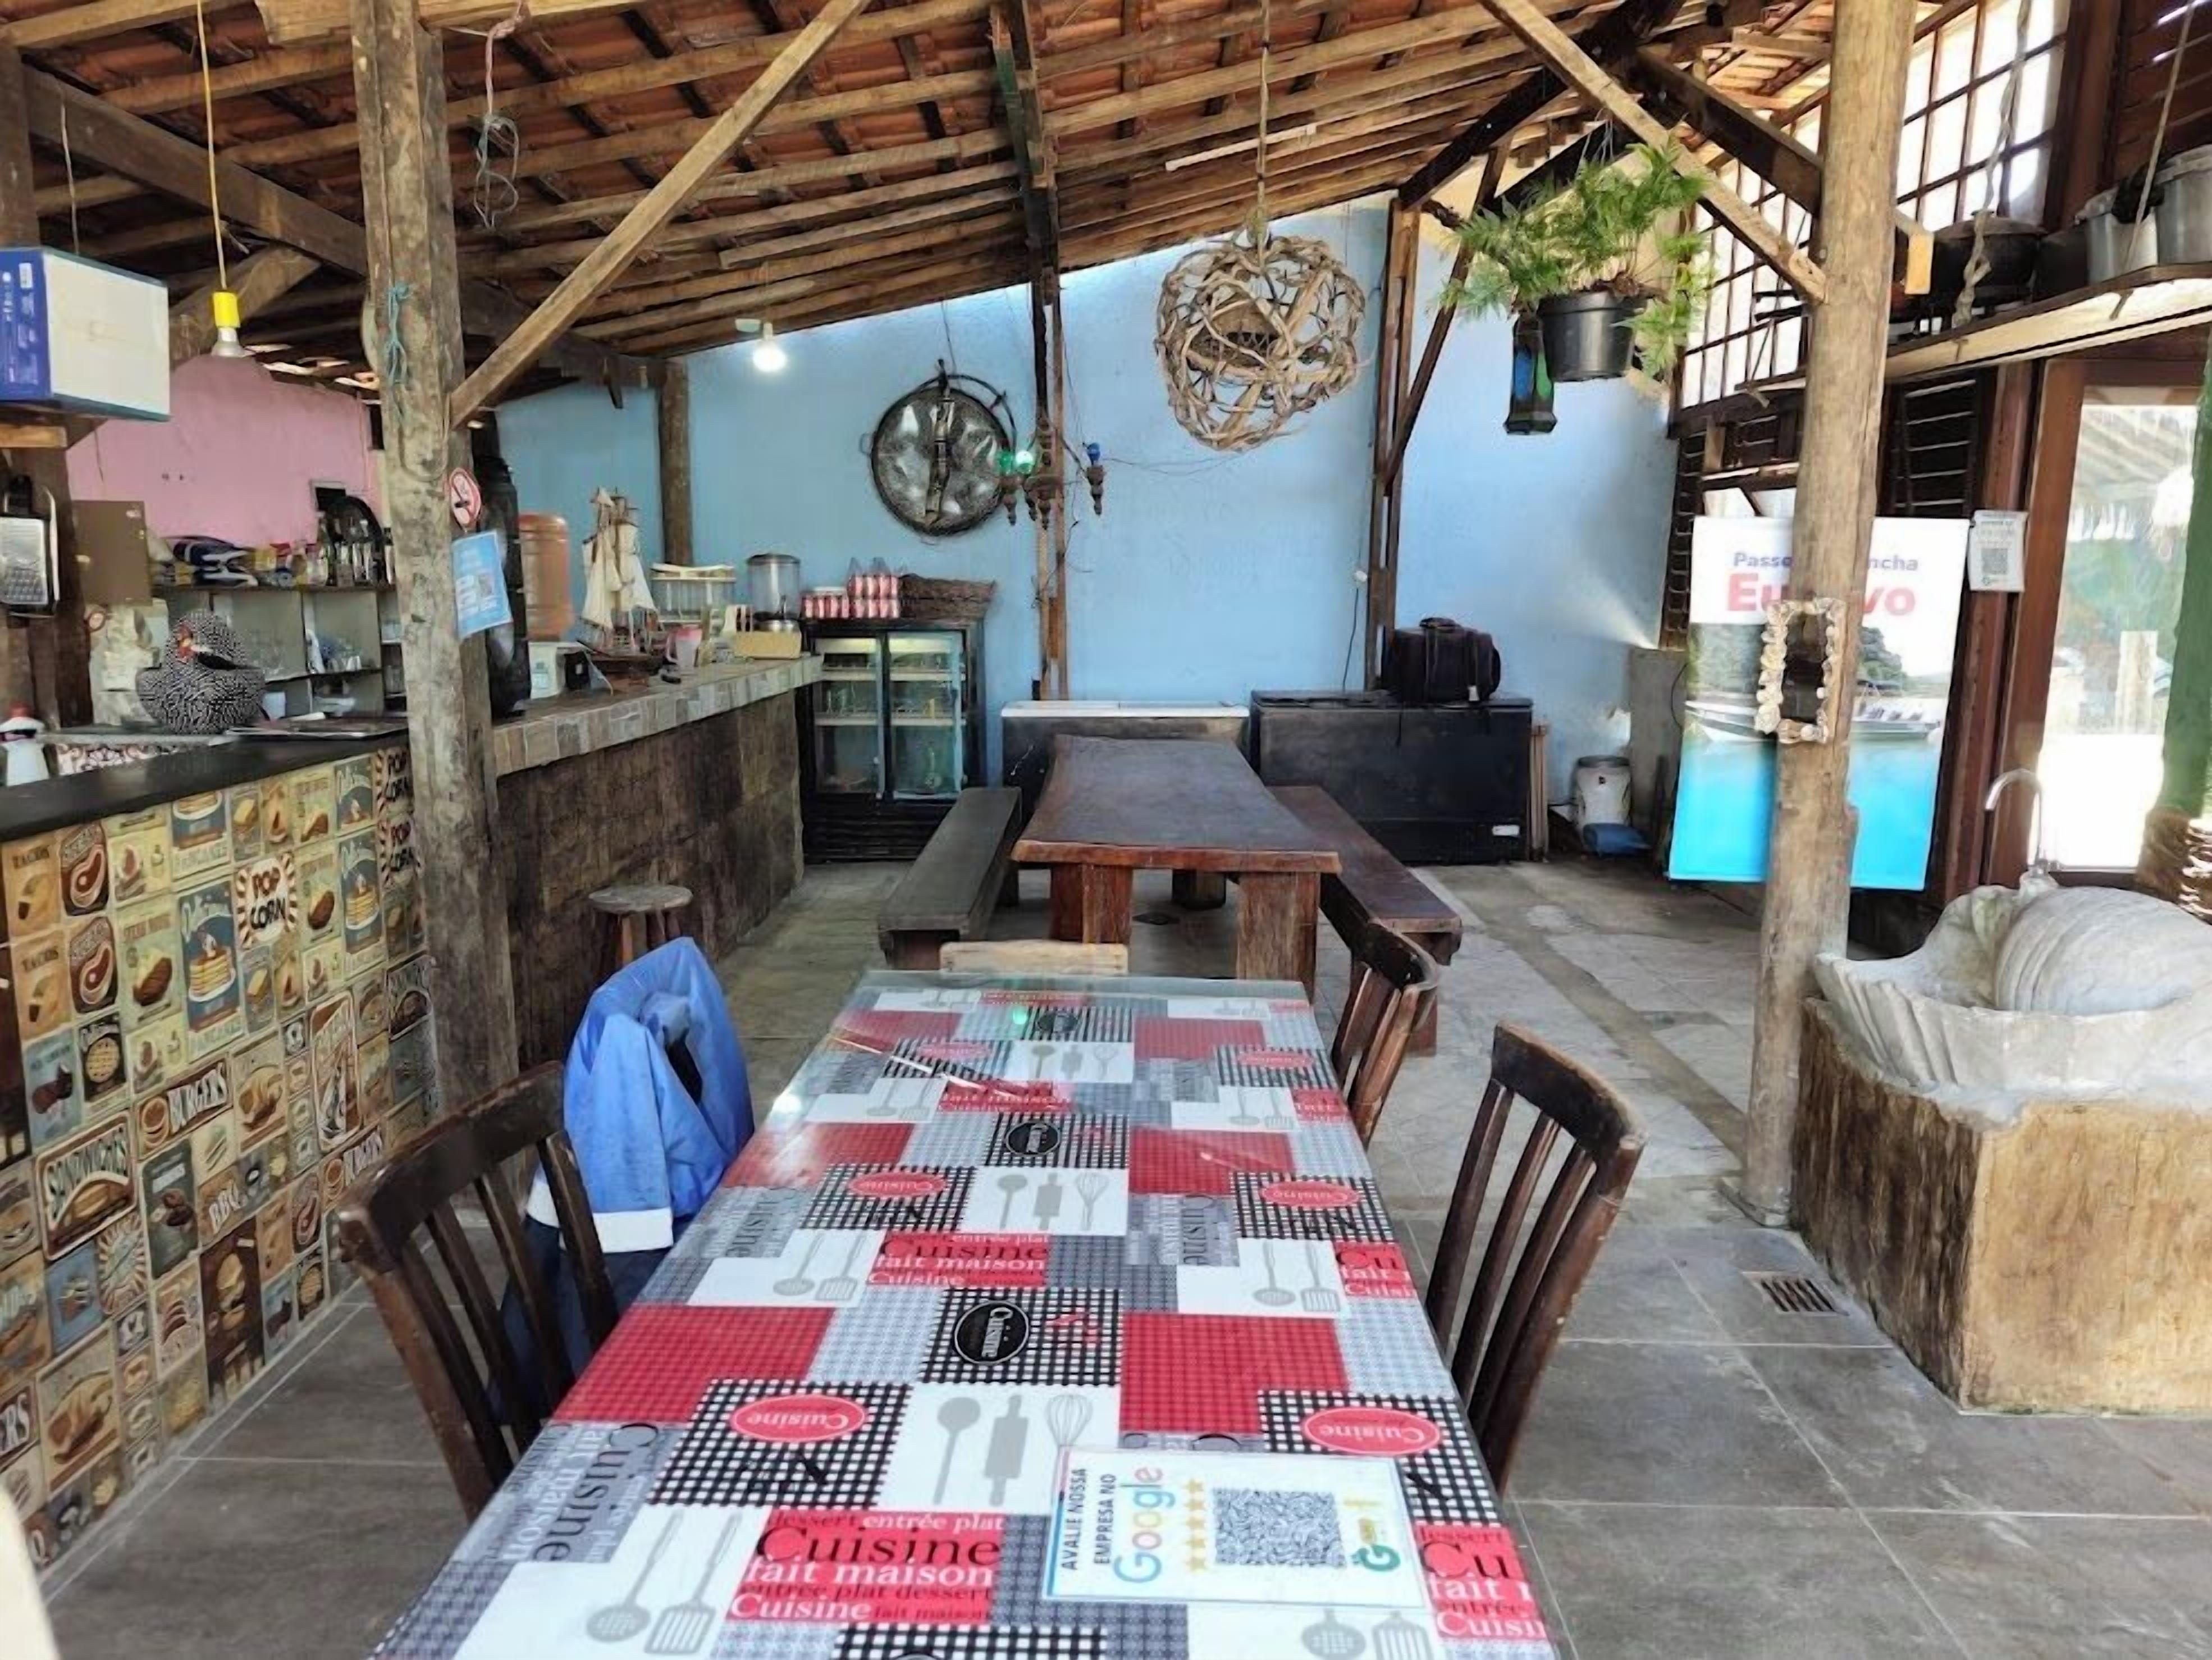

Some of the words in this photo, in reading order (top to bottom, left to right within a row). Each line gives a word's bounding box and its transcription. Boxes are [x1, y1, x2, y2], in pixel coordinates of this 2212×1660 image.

[1733, 552, 1792, 568] Passe
[1868, 555, 1918, 571] ncha
[253, 867, 281, 898] POP
[250, 897, 290, 932] CORN
[880, 1239, 1048, 1260] Cuisine
[936, 1255, 1045, 1270] maison
[869, 1271, 965, 1285] Cuisine
[747, 1411, 849, 1430] Cuisine
[1319, 1422, 1425, 1443] Cuisine
[533, 1422, 659, 1562] Cuisine
[1069, 1468, 1087, 1509] NOSSA
[1100, 1473, 1117, 1495] NO
[953, 1514, 1004, 1534] plat
[1094, 1498, 1114, 1564] EMPRESA
[1113, 1466, 1176, 1584] Google
[757, 1525, 1003, 1566] Cuisine
[1062, 1516, 1083, 1570] AVALIE
[747, 1556, 822, 1583] fait
[834, 1557, 992, 1586] maison
[1429, 1572, 1505, 1600] fait
[731, 1593, 871, 1620] Cuisine
